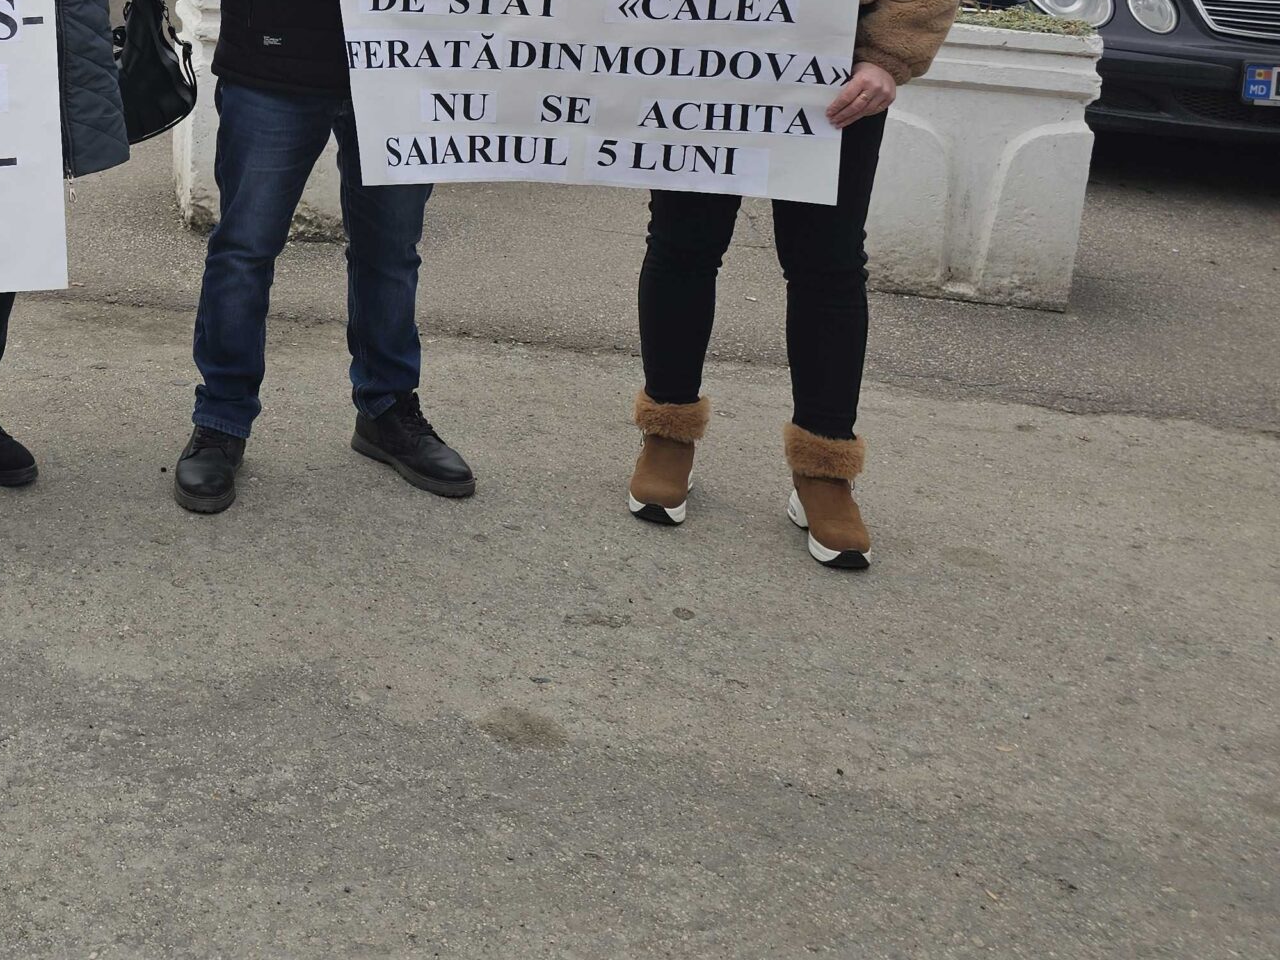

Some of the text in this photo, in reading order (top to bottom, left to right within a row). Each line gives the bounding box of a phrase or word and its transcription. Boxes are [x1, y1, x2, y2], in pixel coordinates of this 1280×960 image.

[346, 33, 501, 70] FERATĂ
[509, 41, 585, 71] DIN
[1250, 84, 1267, 96] MD
[432, 94, 816, 135] NU SE ACHITA
[598, 140, 617, 167] 5
[630, 143, 738, 175] LUNI
